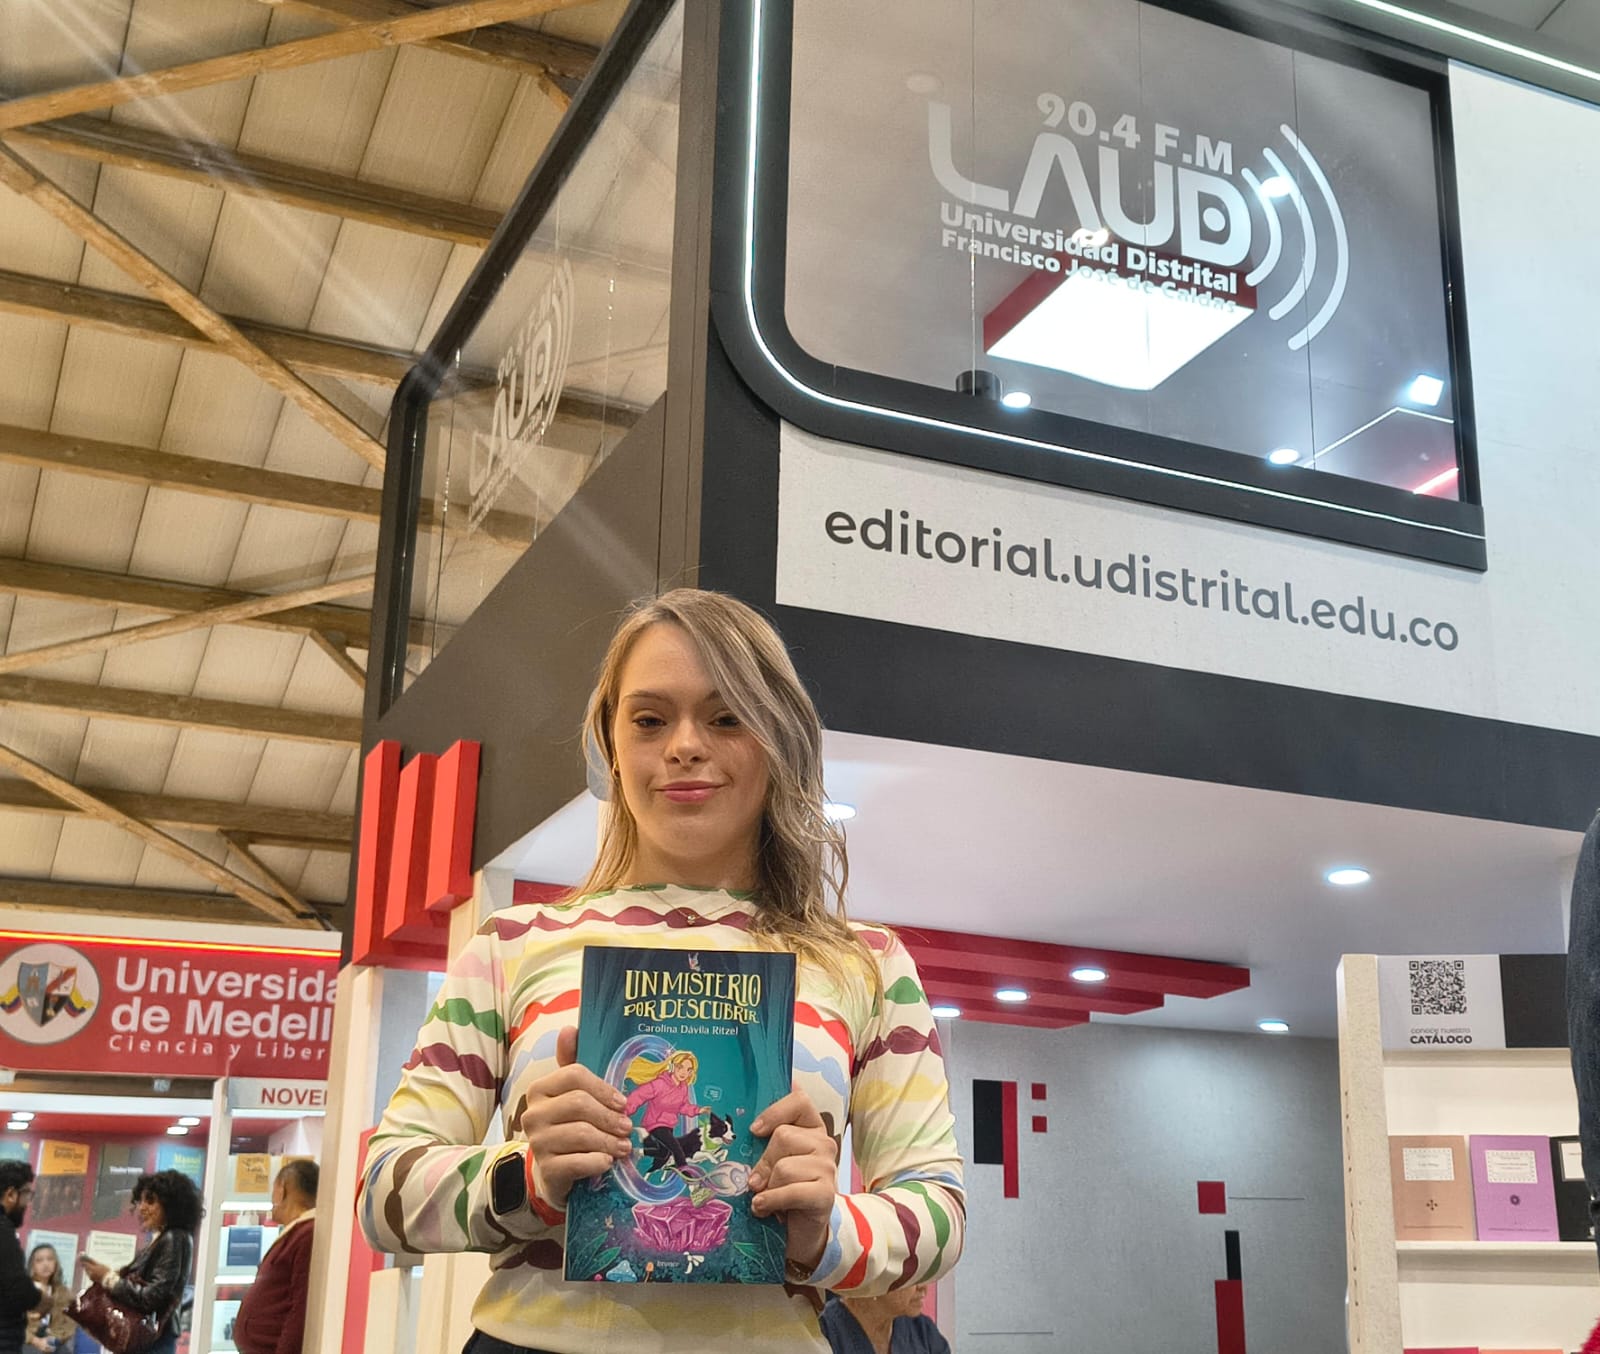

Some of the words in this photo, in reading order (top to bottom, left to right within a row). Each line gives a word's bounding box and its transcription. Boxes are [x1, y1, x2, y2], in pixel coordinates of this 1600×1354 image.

[1036, 93, 1140, 149] 90.4
[1154, 123, 1233, 175] F.M
[928, 100, 1252, 267] LAUD
[940, 202, 1119, 266] Universidad
[1127, 247, 1237, 294] Distrital
[942, 229, 1061, 272] Francisco
[1066, 258, 1118, 286] José
[1127, 273, 1153, 295] de
[1162, 282, 1236, 314] Caldas
[824, 508, 1460, 653] editorial.udistrital.edu.co
[625, 969, 658, 1000] UN
[661, 971, 762, 1007] MISTERIO
[111, 996, 171, 1034] de
[623, 1000, 664, 1022] POR
[659, 999, 760, 1024] DESCUBRIR
[638, 1023, 677, 1034] Carolina
[680, 1024, 710, 1035] Dávila
[712, 1026, 739, 1036] Ritzel
[109, 1034, 214, 1056] Ciencia
[230, 1043, 241, 1060] y
[1410, 1032, 1473, 1044] CATÁLOGO
[261, 1087, 327, 1106] NOVE
